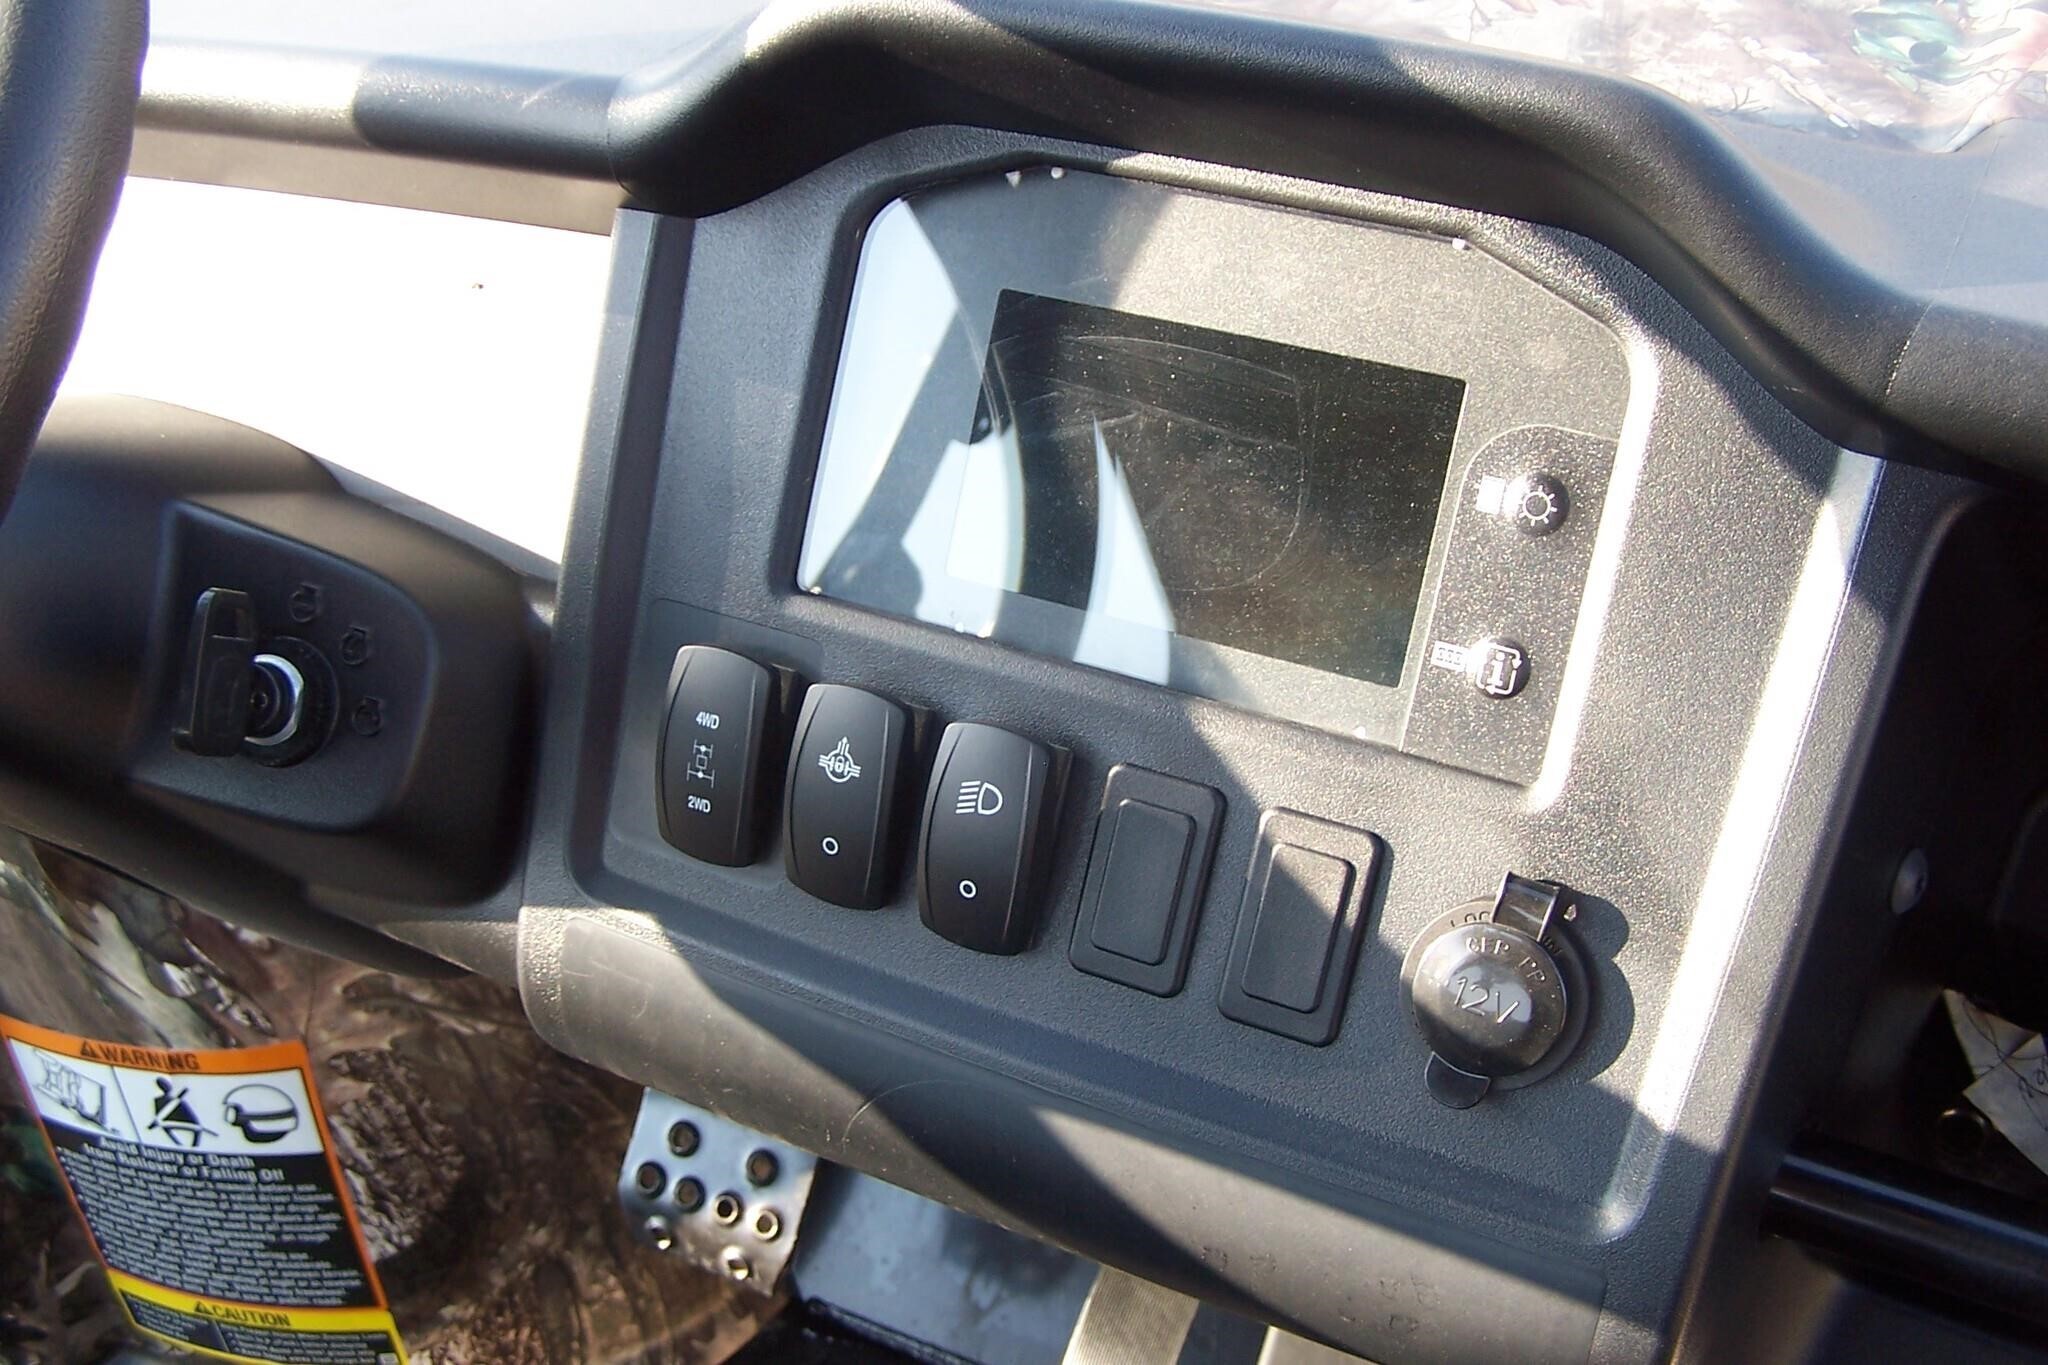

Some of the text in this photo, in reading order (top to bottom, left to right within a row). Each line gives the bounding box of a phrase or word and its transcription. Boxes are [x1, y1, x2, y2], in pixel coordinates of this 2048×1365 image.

[695, 711, 720, 730] 4WD
[687, 795, 711, 814] 2WD
[1454, 976, 1520, 1024] 12V
[98, 1044, 200, 1070] WARNING
[211, 1308, 291, 1327] CAUTION
